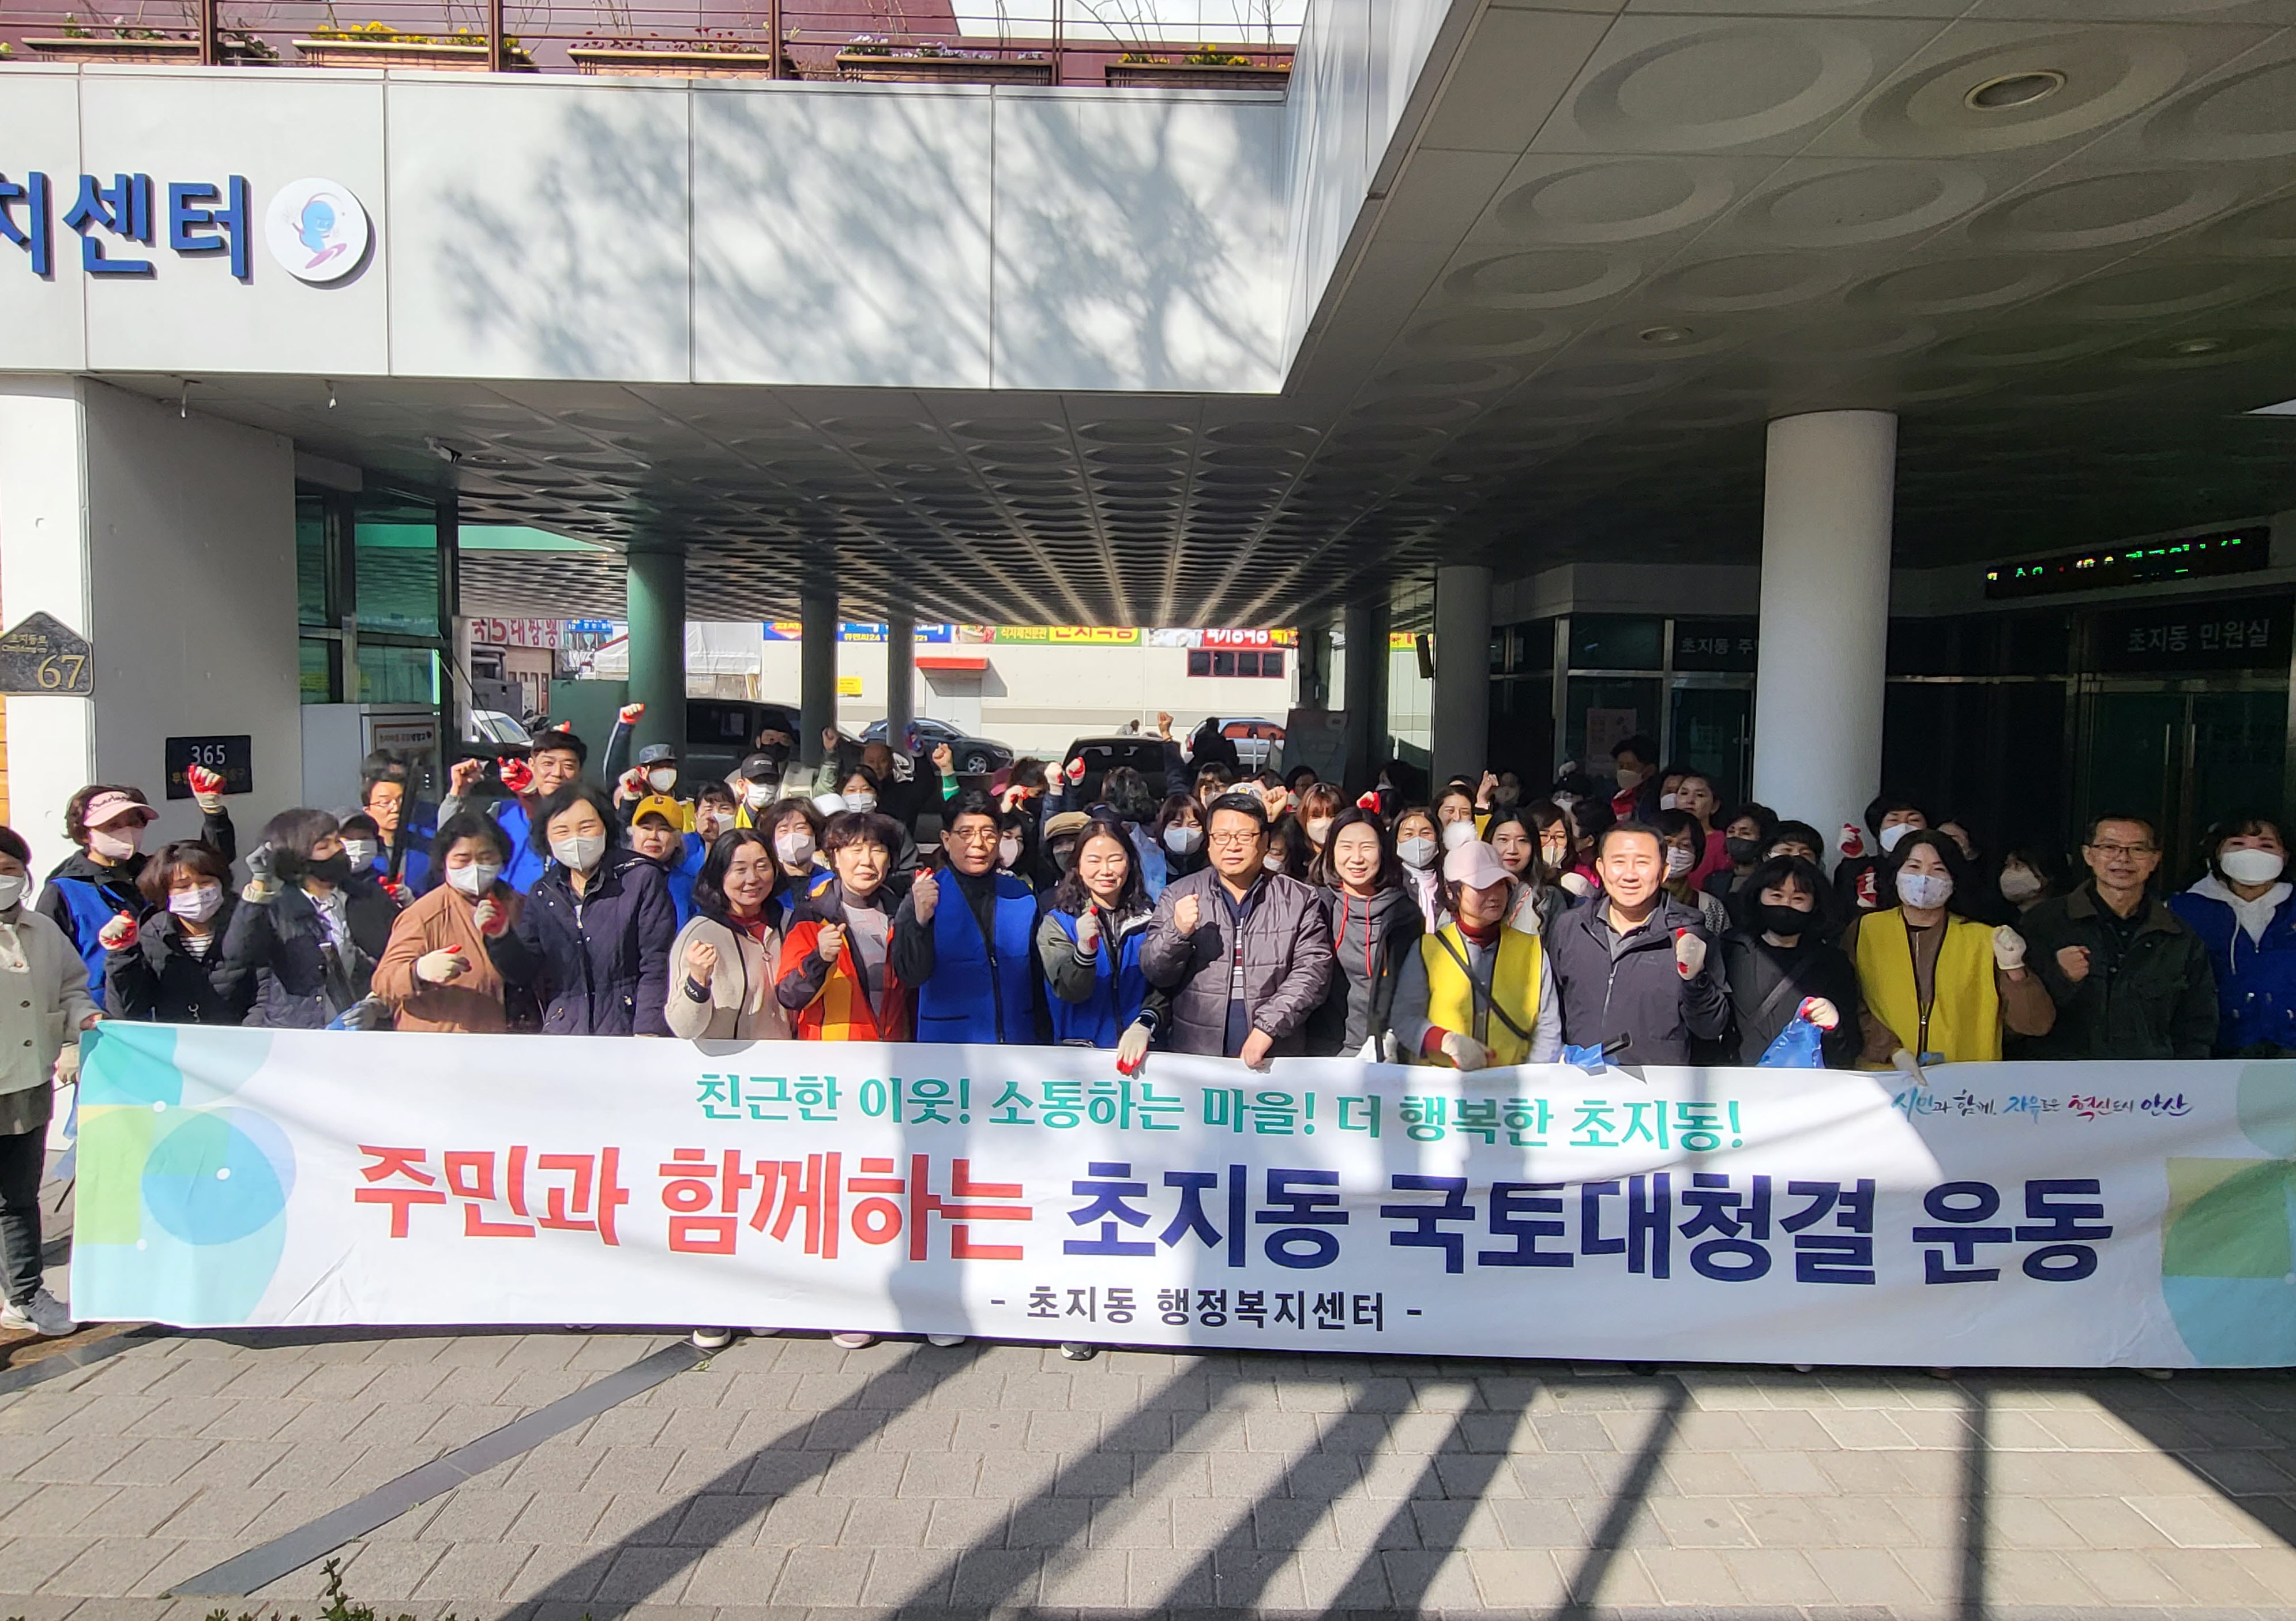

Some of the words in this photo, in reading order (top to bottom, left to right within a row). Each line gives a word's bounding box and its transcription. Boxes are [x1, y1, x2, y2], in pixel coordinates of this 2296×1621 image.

[1679, 637, 1730, 655] 초지동
[2127, 625, 2190, 653] 초지동
[2200, 618, 2270, 651] 민원실
[37, 654, 85, 689] 67
[191, 745, 226, 765] 365
[696, 1074, 841, 1122] 친근한
[858, 1077, 970, 1125] 이웃!
[989, 1080, 1185, 1131] 소통하는
[1203, 1089, 1316, 1136] 마을!
[1337, 1094, 1382, 1139] 더
[1400, 1095, 1554, 1148] 행복한
[1569, 1100, 1744, 1152] 초지동!
[2140, 1093, 2194, 1117] 안산
[354, 1145, 629, 1246] 주민과
[659, 1148, 1032, 1261] 함께하는
[1063, 1162, 1350, 1269] 초지동
[1380, 1172, 1876, 1284] 국토대청결
[1912, 1178, 2114, 1285] 운동
[1027, 1285, 1137, 1324] 초지동
[1157, 1288, 1384, 1332] 행정복지센터
